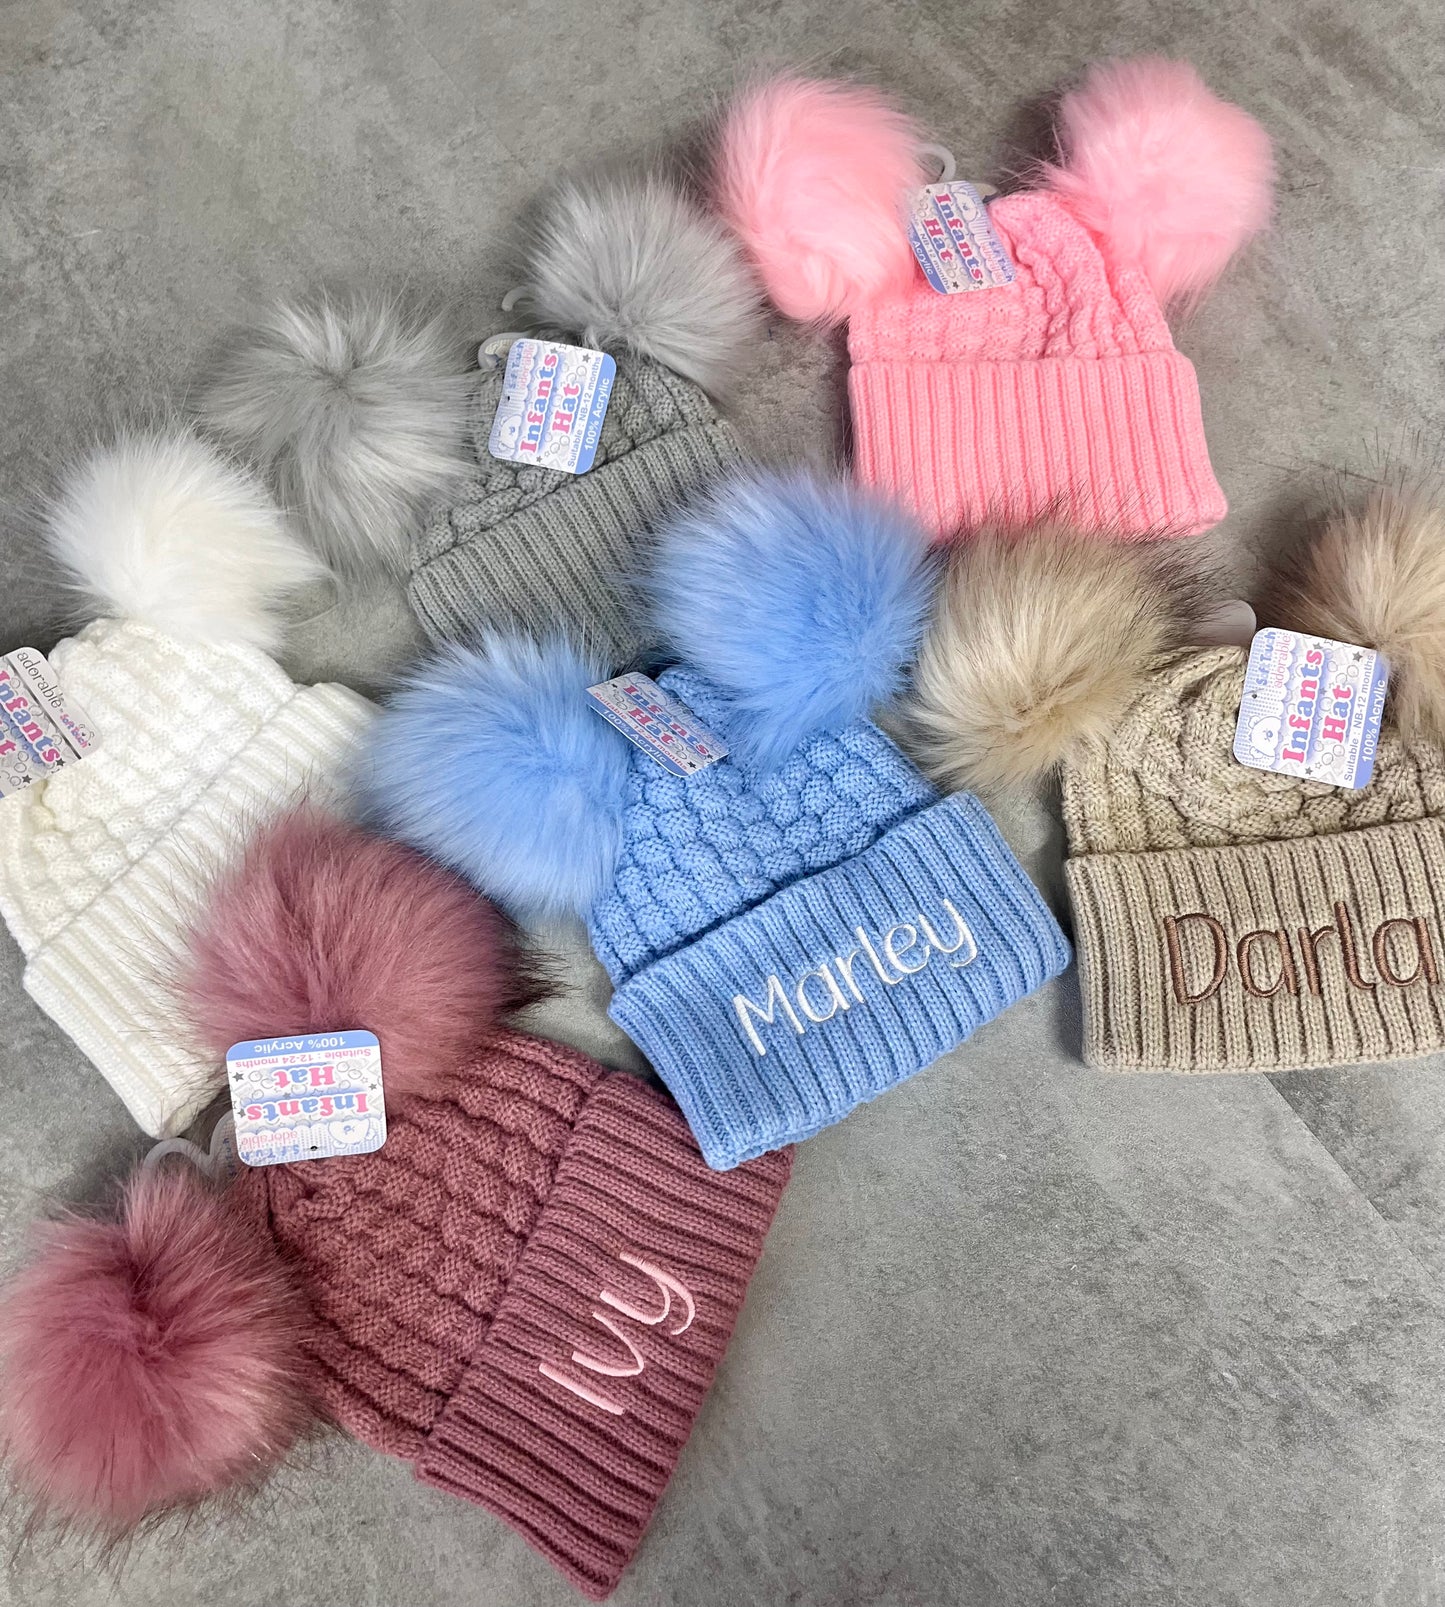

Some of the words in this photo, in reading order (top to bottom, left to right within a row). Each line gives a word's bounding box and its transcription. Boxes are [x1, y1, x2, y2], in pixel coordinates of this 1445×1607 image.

[912, 240, 934, 275] Acrylic
[924, 218, 953, 262] Hat
[935, 193, 984, 281] Infants
[933, 256, 951, 290] months
[520, 354, 557, 453] Infants
[552, 383, 580, 434] Hat
[567, 429, 583, 467] Suitable
[579, 393, 592, 421] NB-12
[587, 356, 601, 393] months
[583, 419, 599, 451] 100%
[593, 378, 610, 418] Acrylic
[16, 652, 62, 709] adorable
[1271, 634, 1291, 688] adorable
[623, 685, 709, 755] Infants
[628, 707, 676, 745] Hat
[1282, 650, 1322, 763] Infants
[1322, 684, 1351, 743] Hat
[1344, 738, 1359, 782] Suitable
[1353, 696, 1367, 729] NB-12
[1362, 655, 1375, 695] months
[1369, 679, 1386, 726] Acrylic
[594, 692, 628, 720] Suitable
[656, 744, 688, 770] months
[603, 710, 632, 733] 100%
[630, 733, 667, 763] Acrylic
[1362, 729, 1378, 762] 100%
[733, 899, 977, 1056] Marley
[1163, 901, 1440, 1005] Darla
[235, 1057, 279, 1068] months
[254, 1040, 304, 1054] Acrylic
[283, 1054, 314, 1064] 12-24
[308, 1036, 347, 1049] 100%
[325, 1048, 372, 1059] Suitable
[273, 1066, 335, 1089] Hat
[246, 1093, 369, 1121] Infants
[240, 1131, 298, 1148] adorable
[538, 1251, 695, 1416] Ivy
